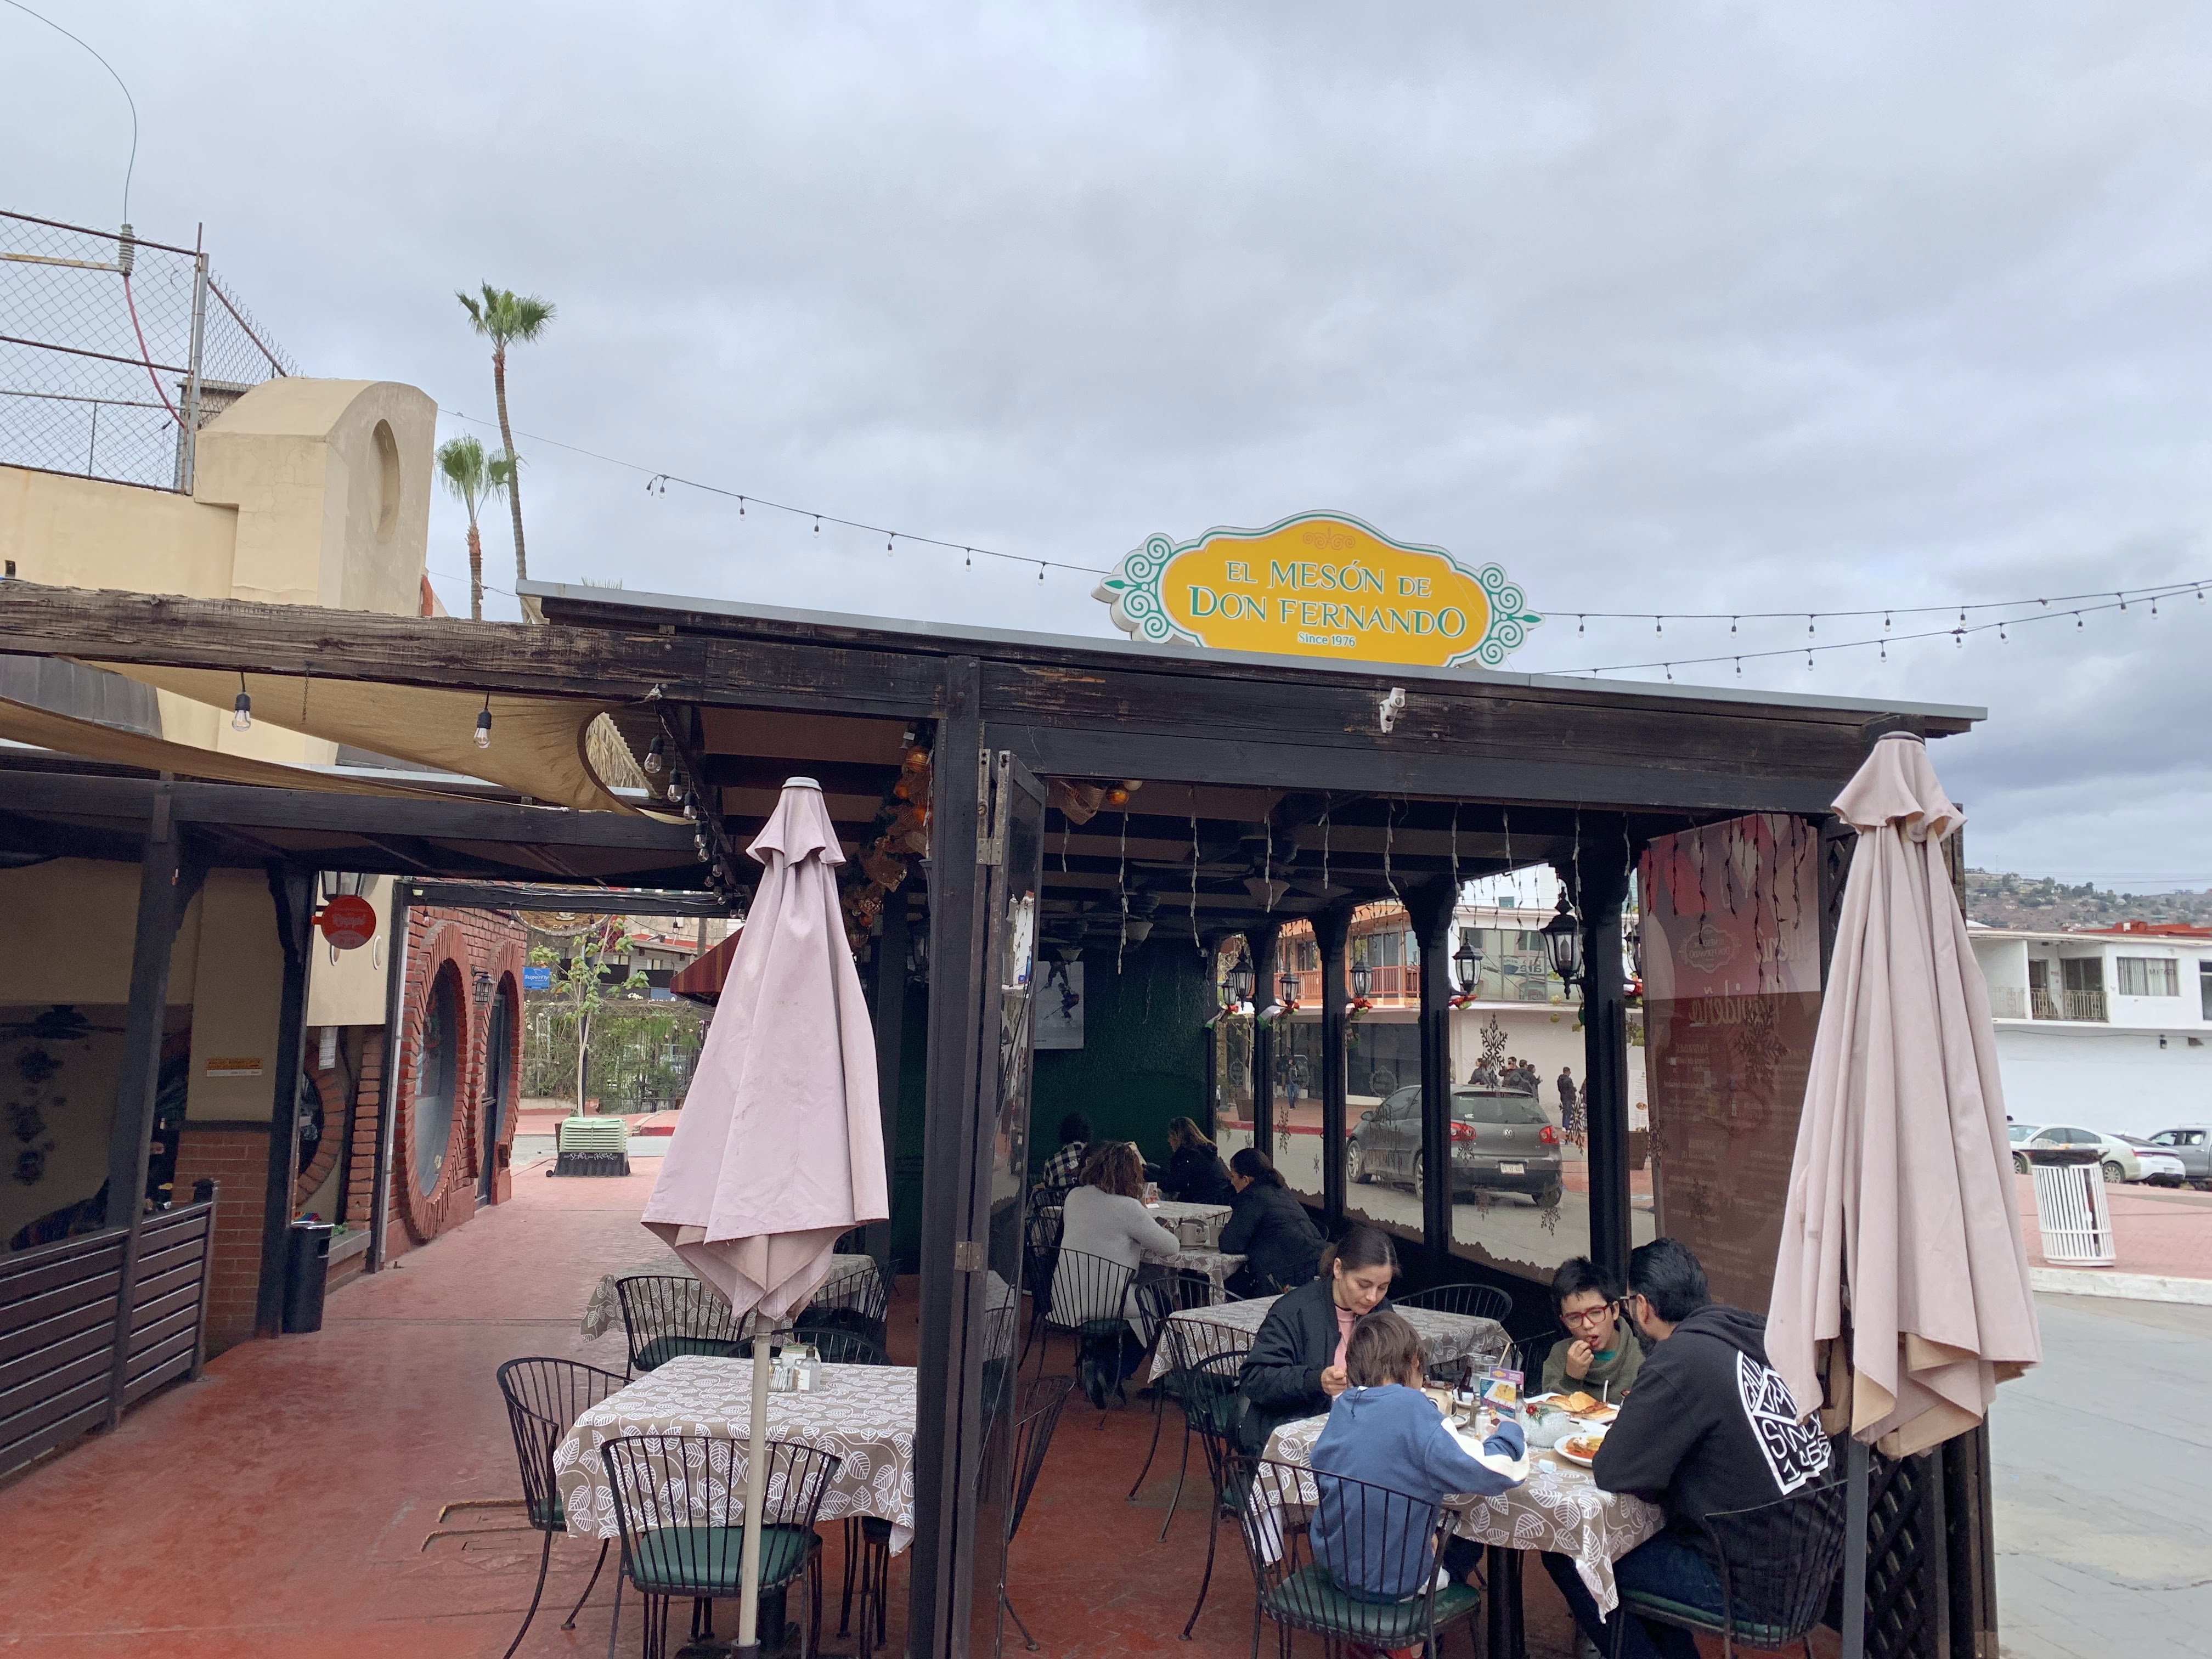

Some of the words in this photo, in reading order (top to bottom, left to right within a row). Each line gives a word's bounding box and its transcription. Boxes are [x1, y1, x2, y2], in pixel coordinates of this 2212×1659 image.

[1226, 561, 1259, 585] EL
[1267, 559, 1385, 596] MESÓN
[1396, 575, 1432, 599] DE
[1187, 585, 1267, 622] DON
[1280, 597, 1468, 639] FERNANDO
[1297, 631, 1328, 646] Since
[1330, 634, 1357, 648] 1976
